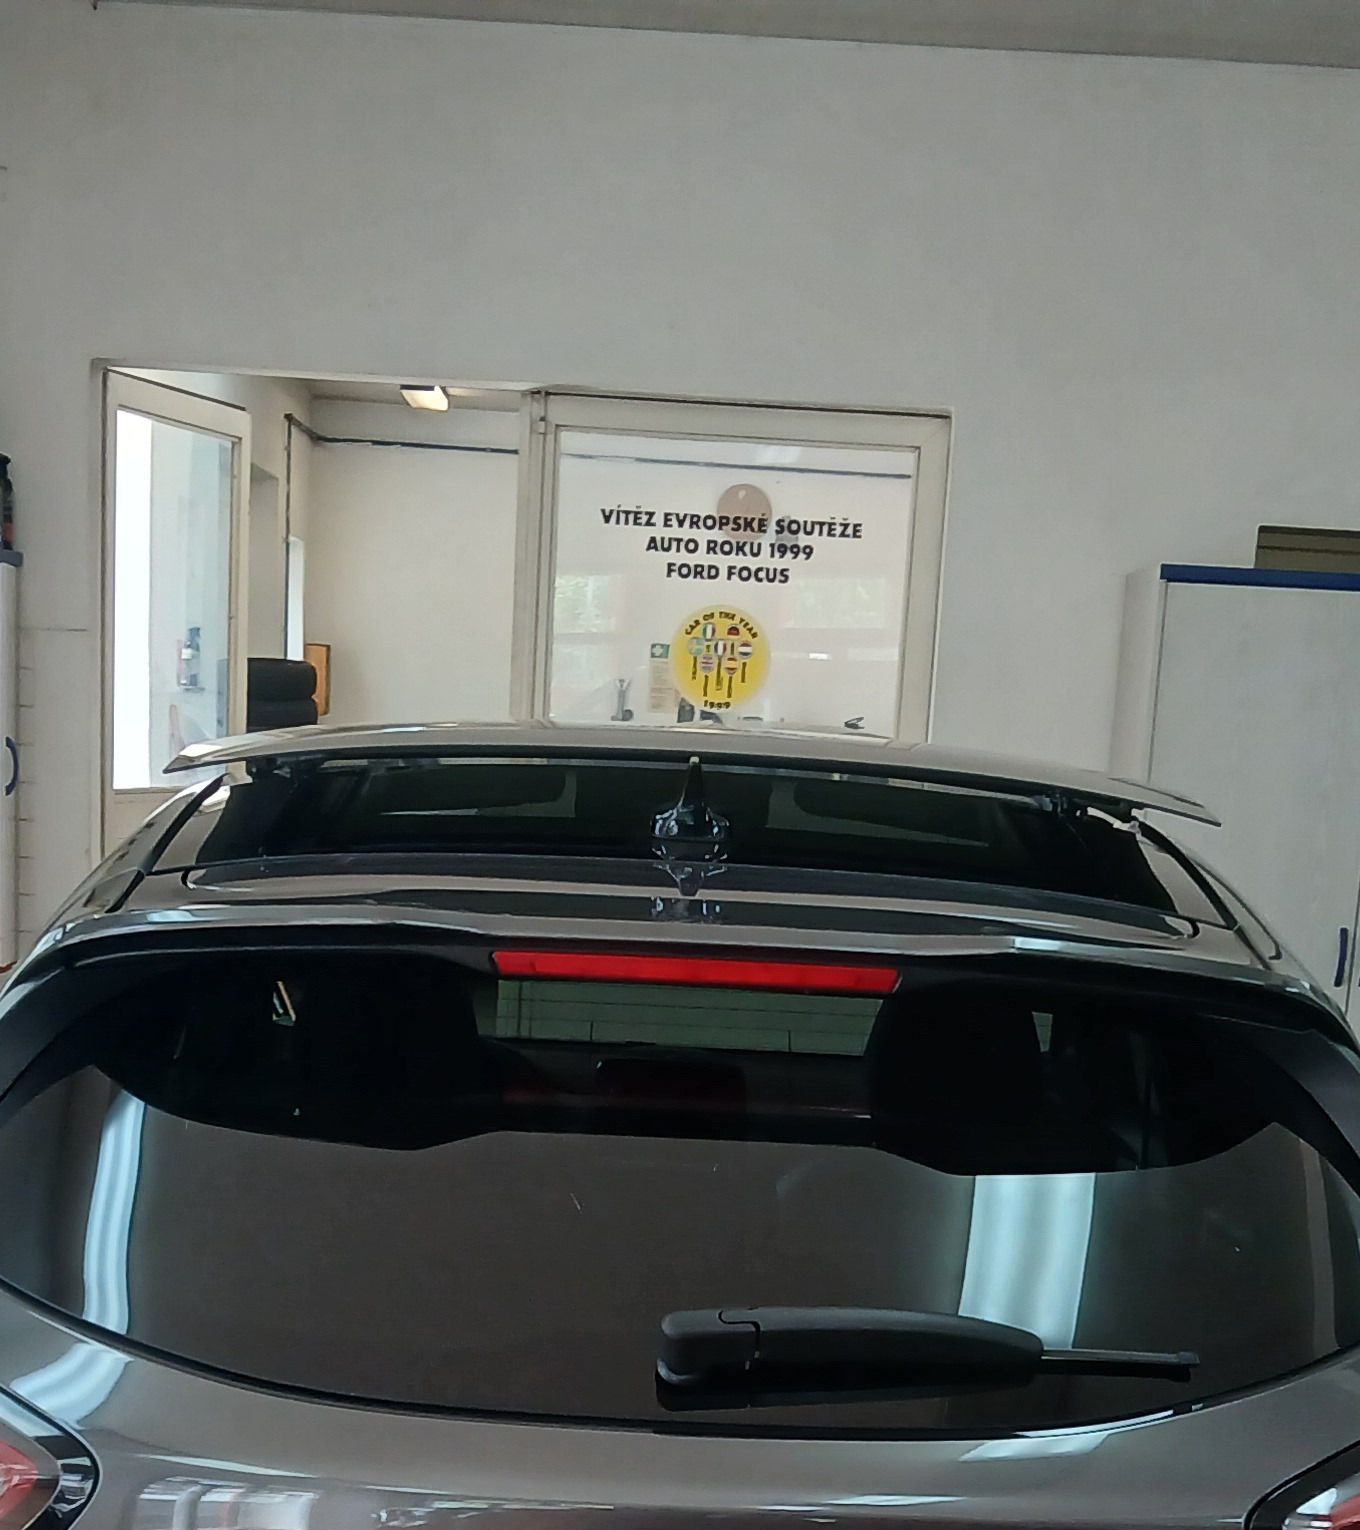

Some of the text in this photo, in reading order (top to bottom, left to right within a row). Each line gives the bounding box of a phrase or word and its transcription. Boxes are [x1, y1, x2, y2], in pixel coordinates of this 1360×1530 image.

[601, 504, 863, 539] VÍTĚZ EVROPSKÉ SOUTĚŽE
[646, 536, 814, 561] AUTO ROKU 1999
[666, 562, 790, 584] FORD FOCUS
[685, 619, 701, 635] CAR
[739, 617, 758, 639] YEAR
